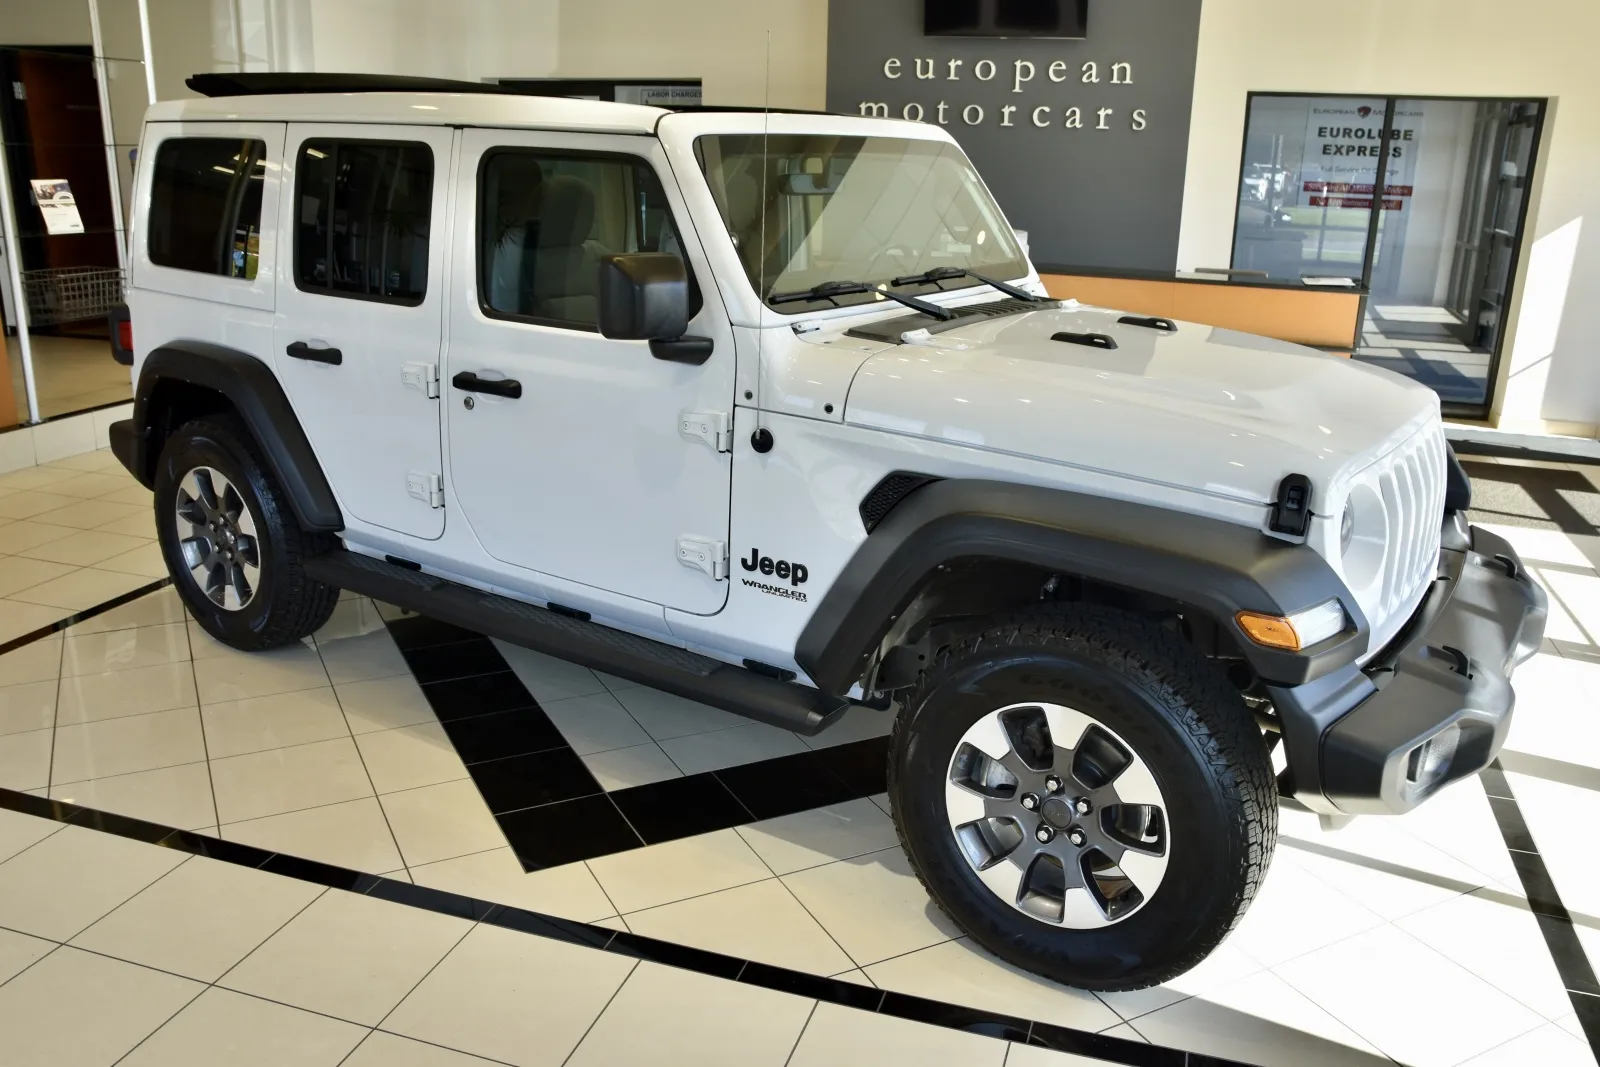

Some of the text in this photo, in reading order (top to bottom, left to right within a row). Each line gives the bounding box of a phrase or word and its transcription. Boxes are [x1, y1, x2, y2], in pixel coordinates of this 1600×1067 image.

[884, 57, 1133, 92] european
[859, 100, 1147, 131] motorcars
[1322, 144, 1402, 158] EXPRES
[741, 547, 808, 586] Jeep
[741, 578, 807, 599] WRANGLER
